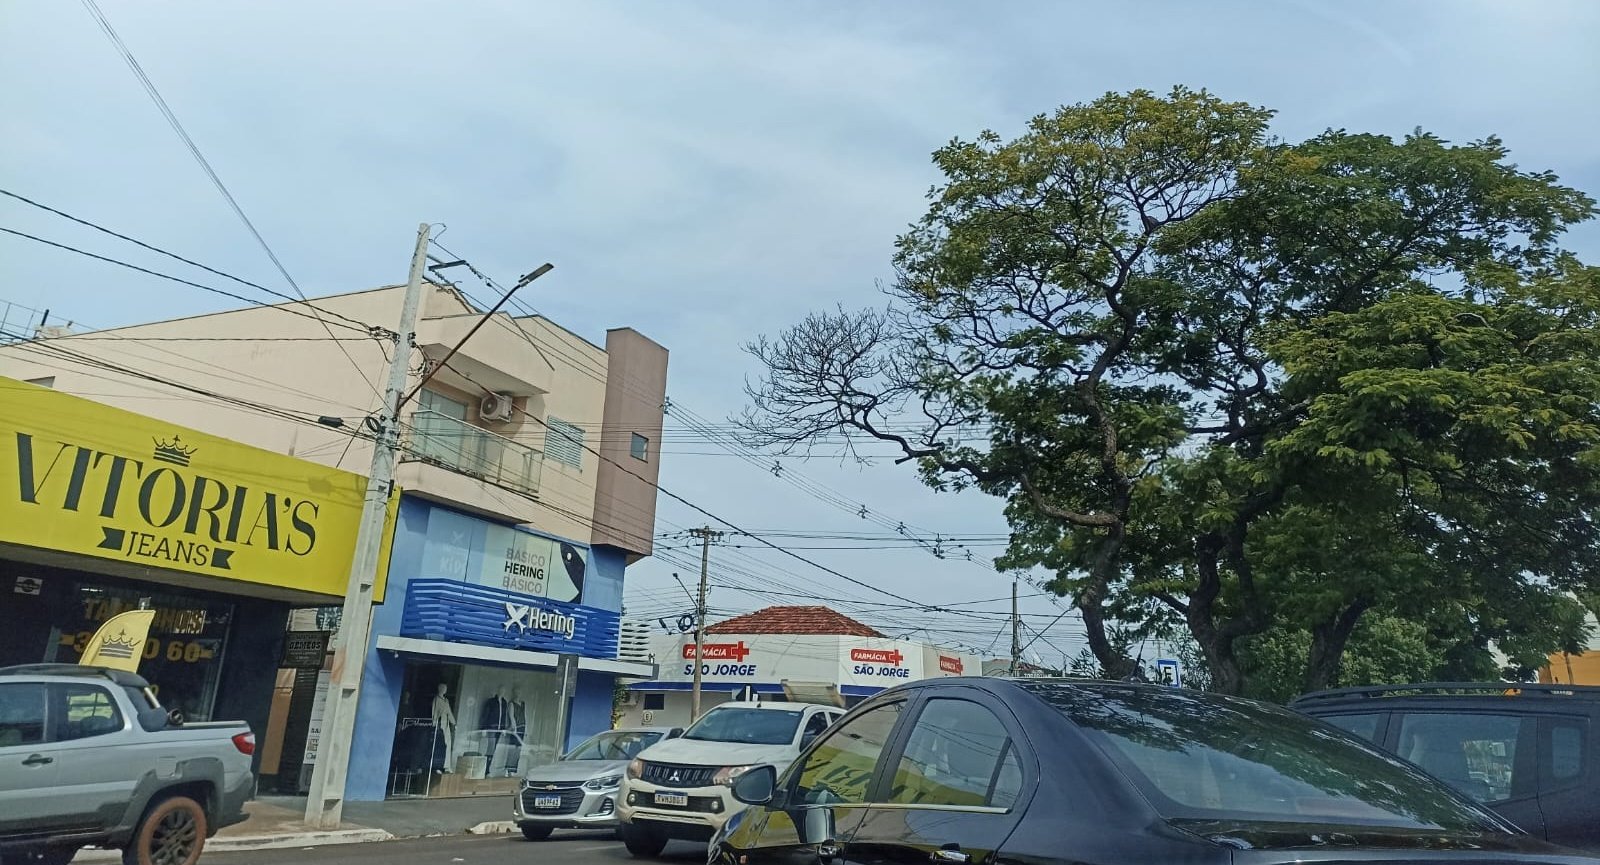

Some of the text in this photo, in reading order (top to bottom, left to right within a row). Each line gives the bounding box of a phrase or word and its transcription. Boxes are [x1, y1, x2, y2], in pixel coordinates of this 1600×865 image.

[16, 432, 319, 556] VITORIA'S
[126, 531, 210, 567] JEANS
[504, 561, 544, 580] HERING
[528, 606, 576, 640] Hering
[166, 641, 201, 663] 60
[686, 647, 727, 657] FAMÁCIA
[684, 664, 757, 676] SO JORGE
[853, 663, 910, 678] SÃO JORGE
